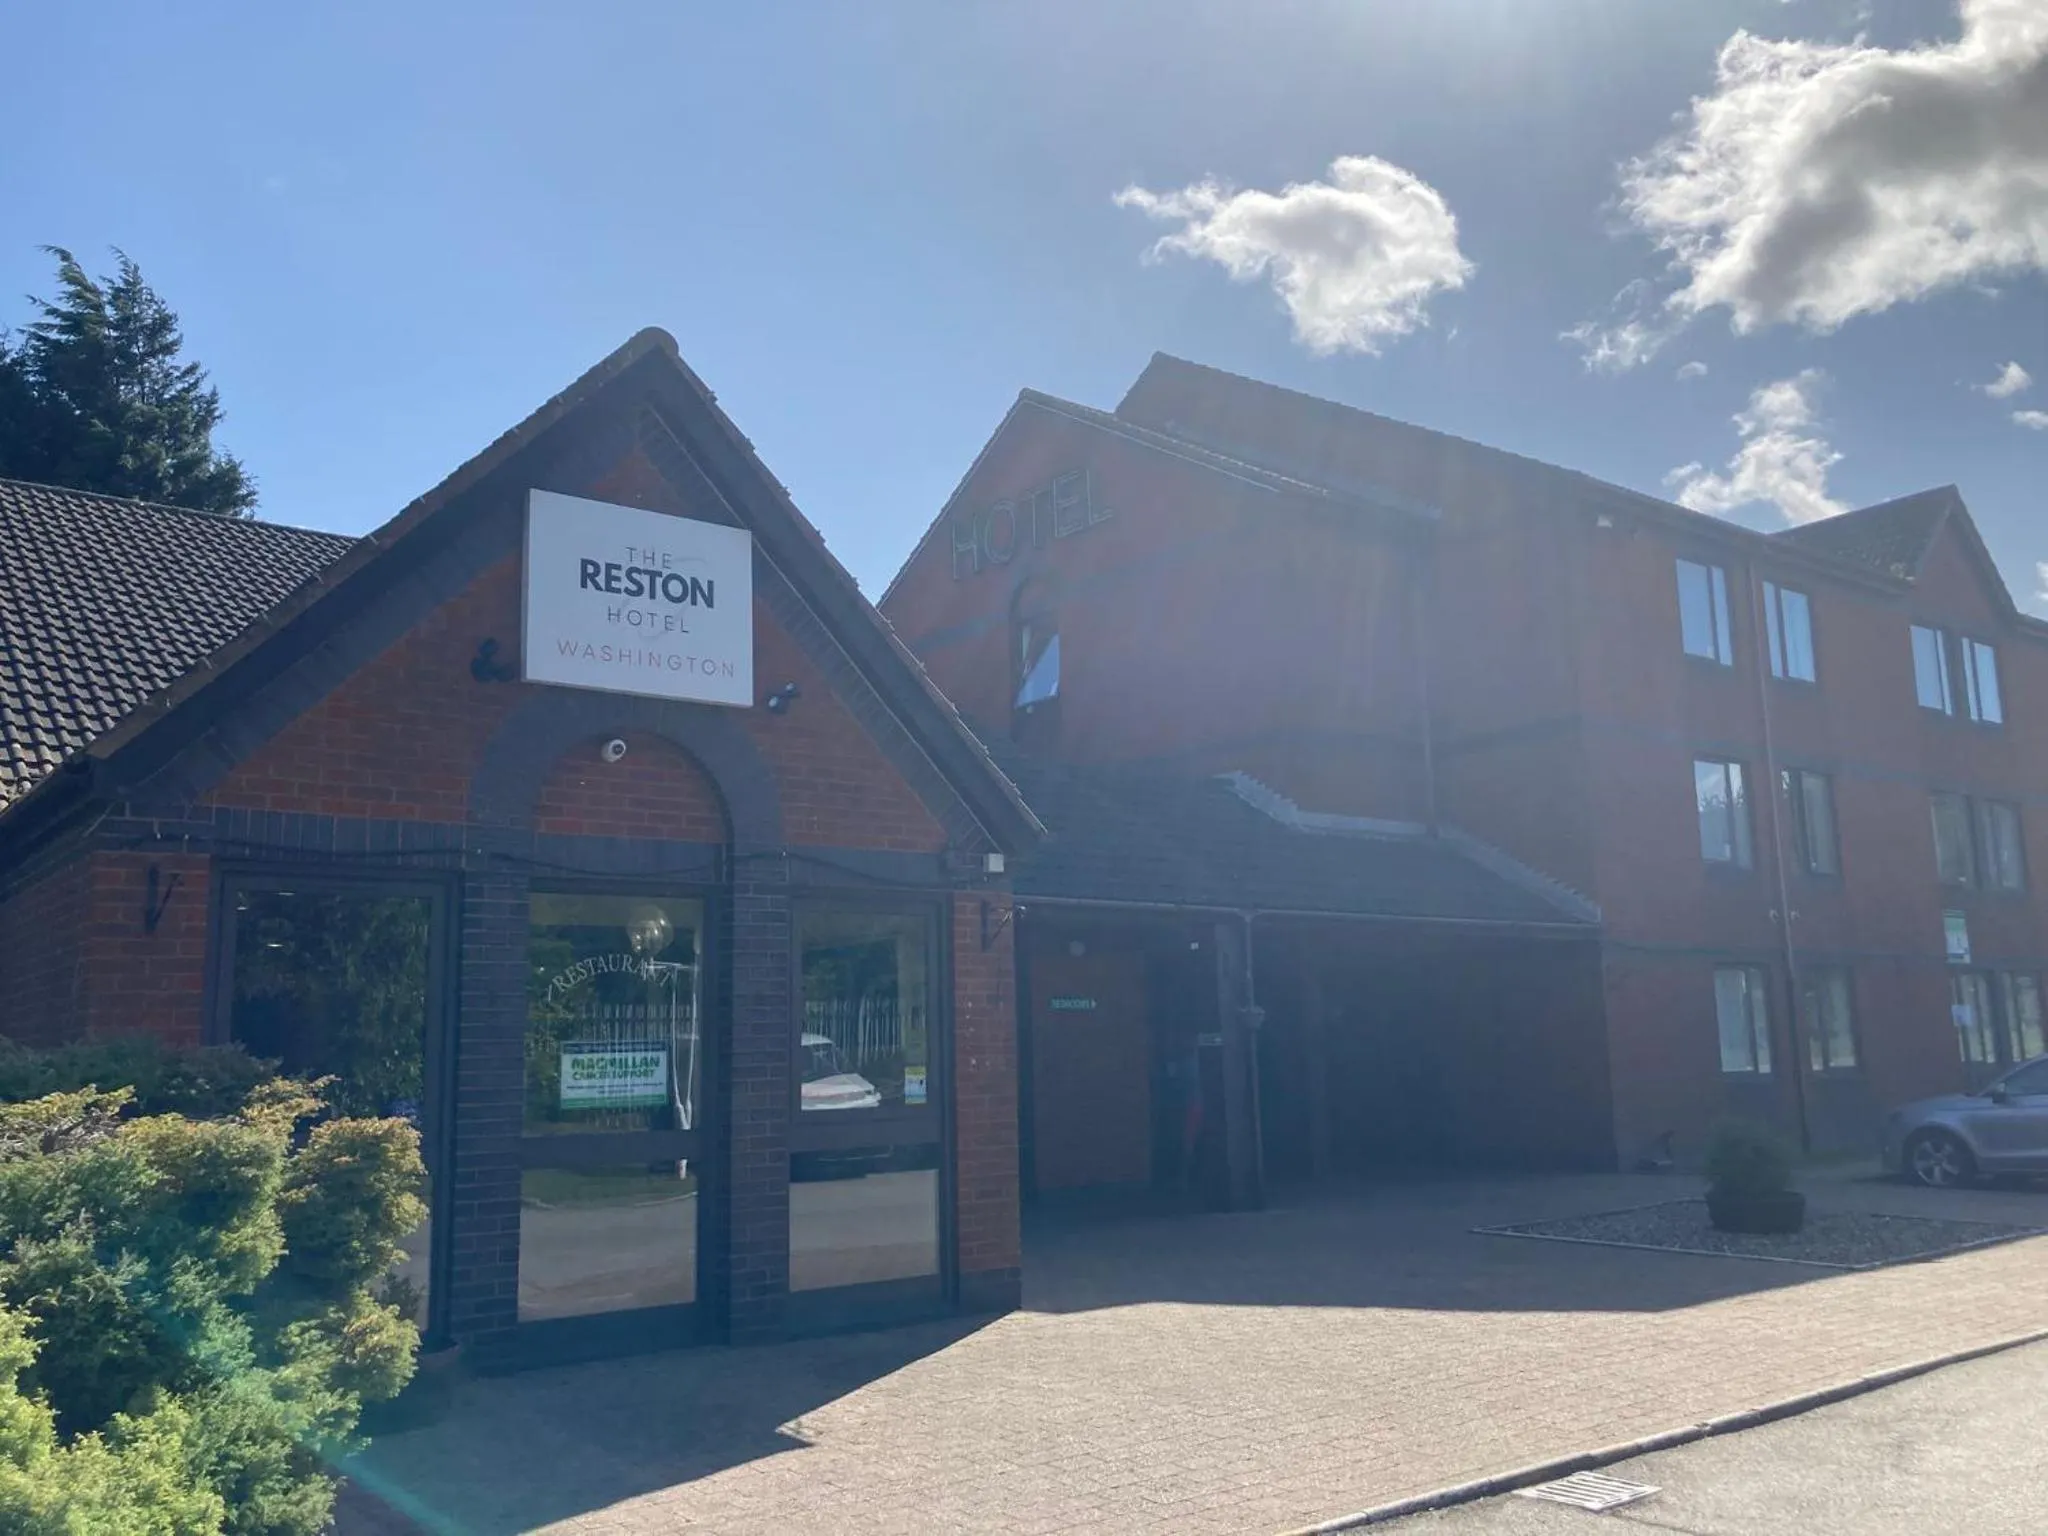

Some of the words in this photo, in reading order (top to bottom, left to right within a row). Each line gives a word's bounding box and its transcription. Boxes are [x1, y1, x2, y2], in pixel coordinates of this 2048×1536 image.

[952, 468, 1114, 581] HOTEL
[625, 546, 673, 569] THE
[580, 558, 714, 609] RESTON
[607, 605, 690, 634] HOTEL
[556, 638, 735, 678] WASHINGTON
[571, 1056, 660, 1071] MACMILLAN
